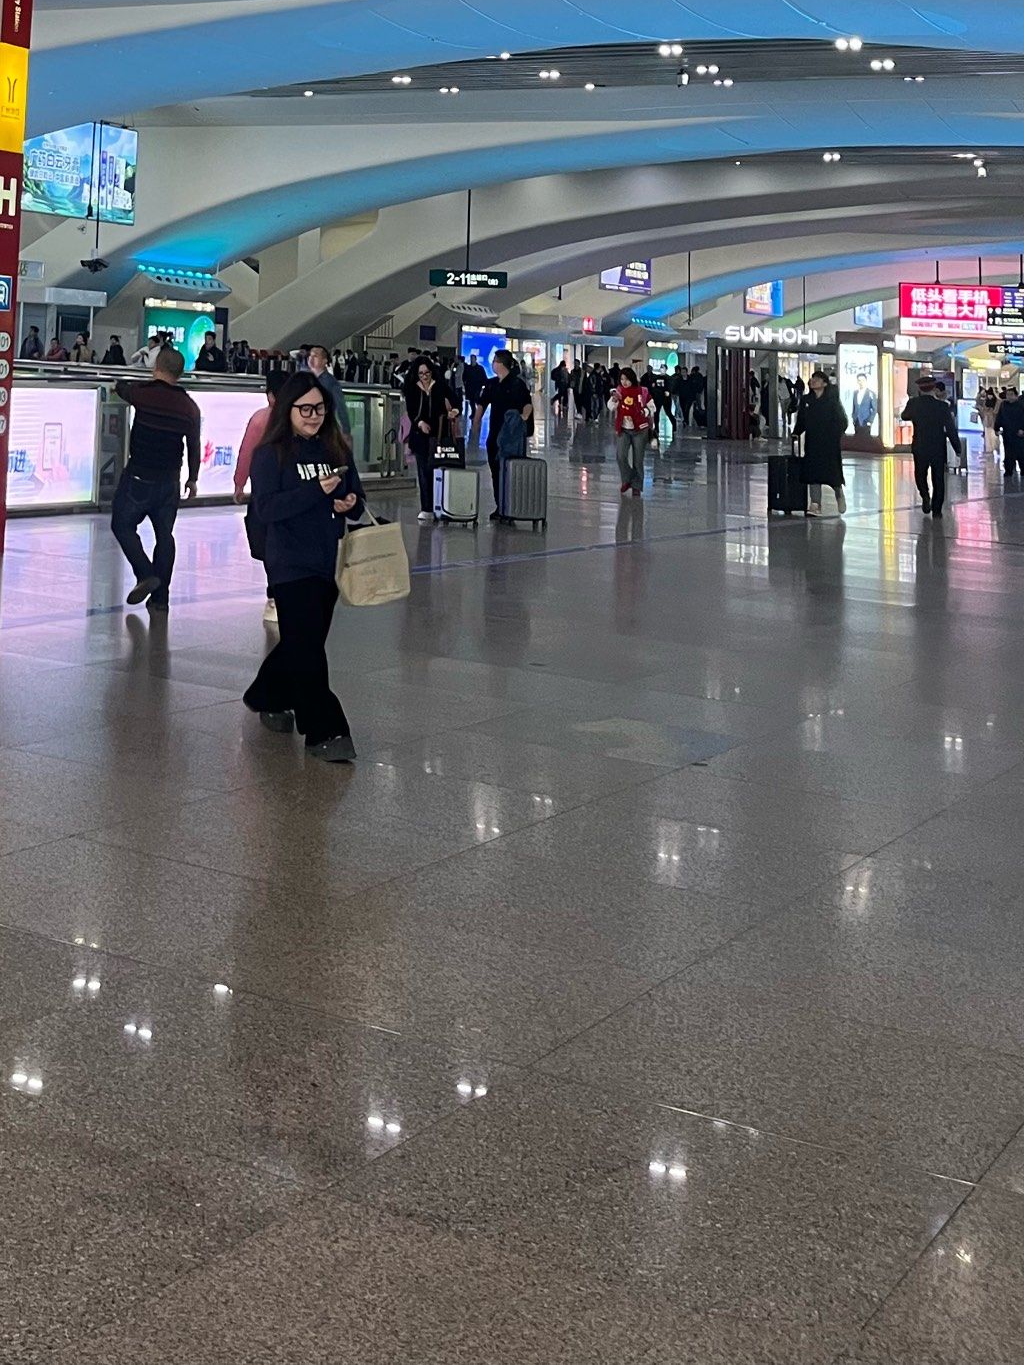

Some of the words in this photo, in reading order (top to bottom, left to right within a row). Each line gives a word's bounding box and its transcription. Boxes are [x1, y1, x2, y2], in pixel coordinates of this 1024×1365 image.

[911, 288, 990, 304] 低头看手机
[725, 325, 818, 346] SUNHOHI
[1, 337, 9, 348] 01
[0, 364, 7, 375] 01
